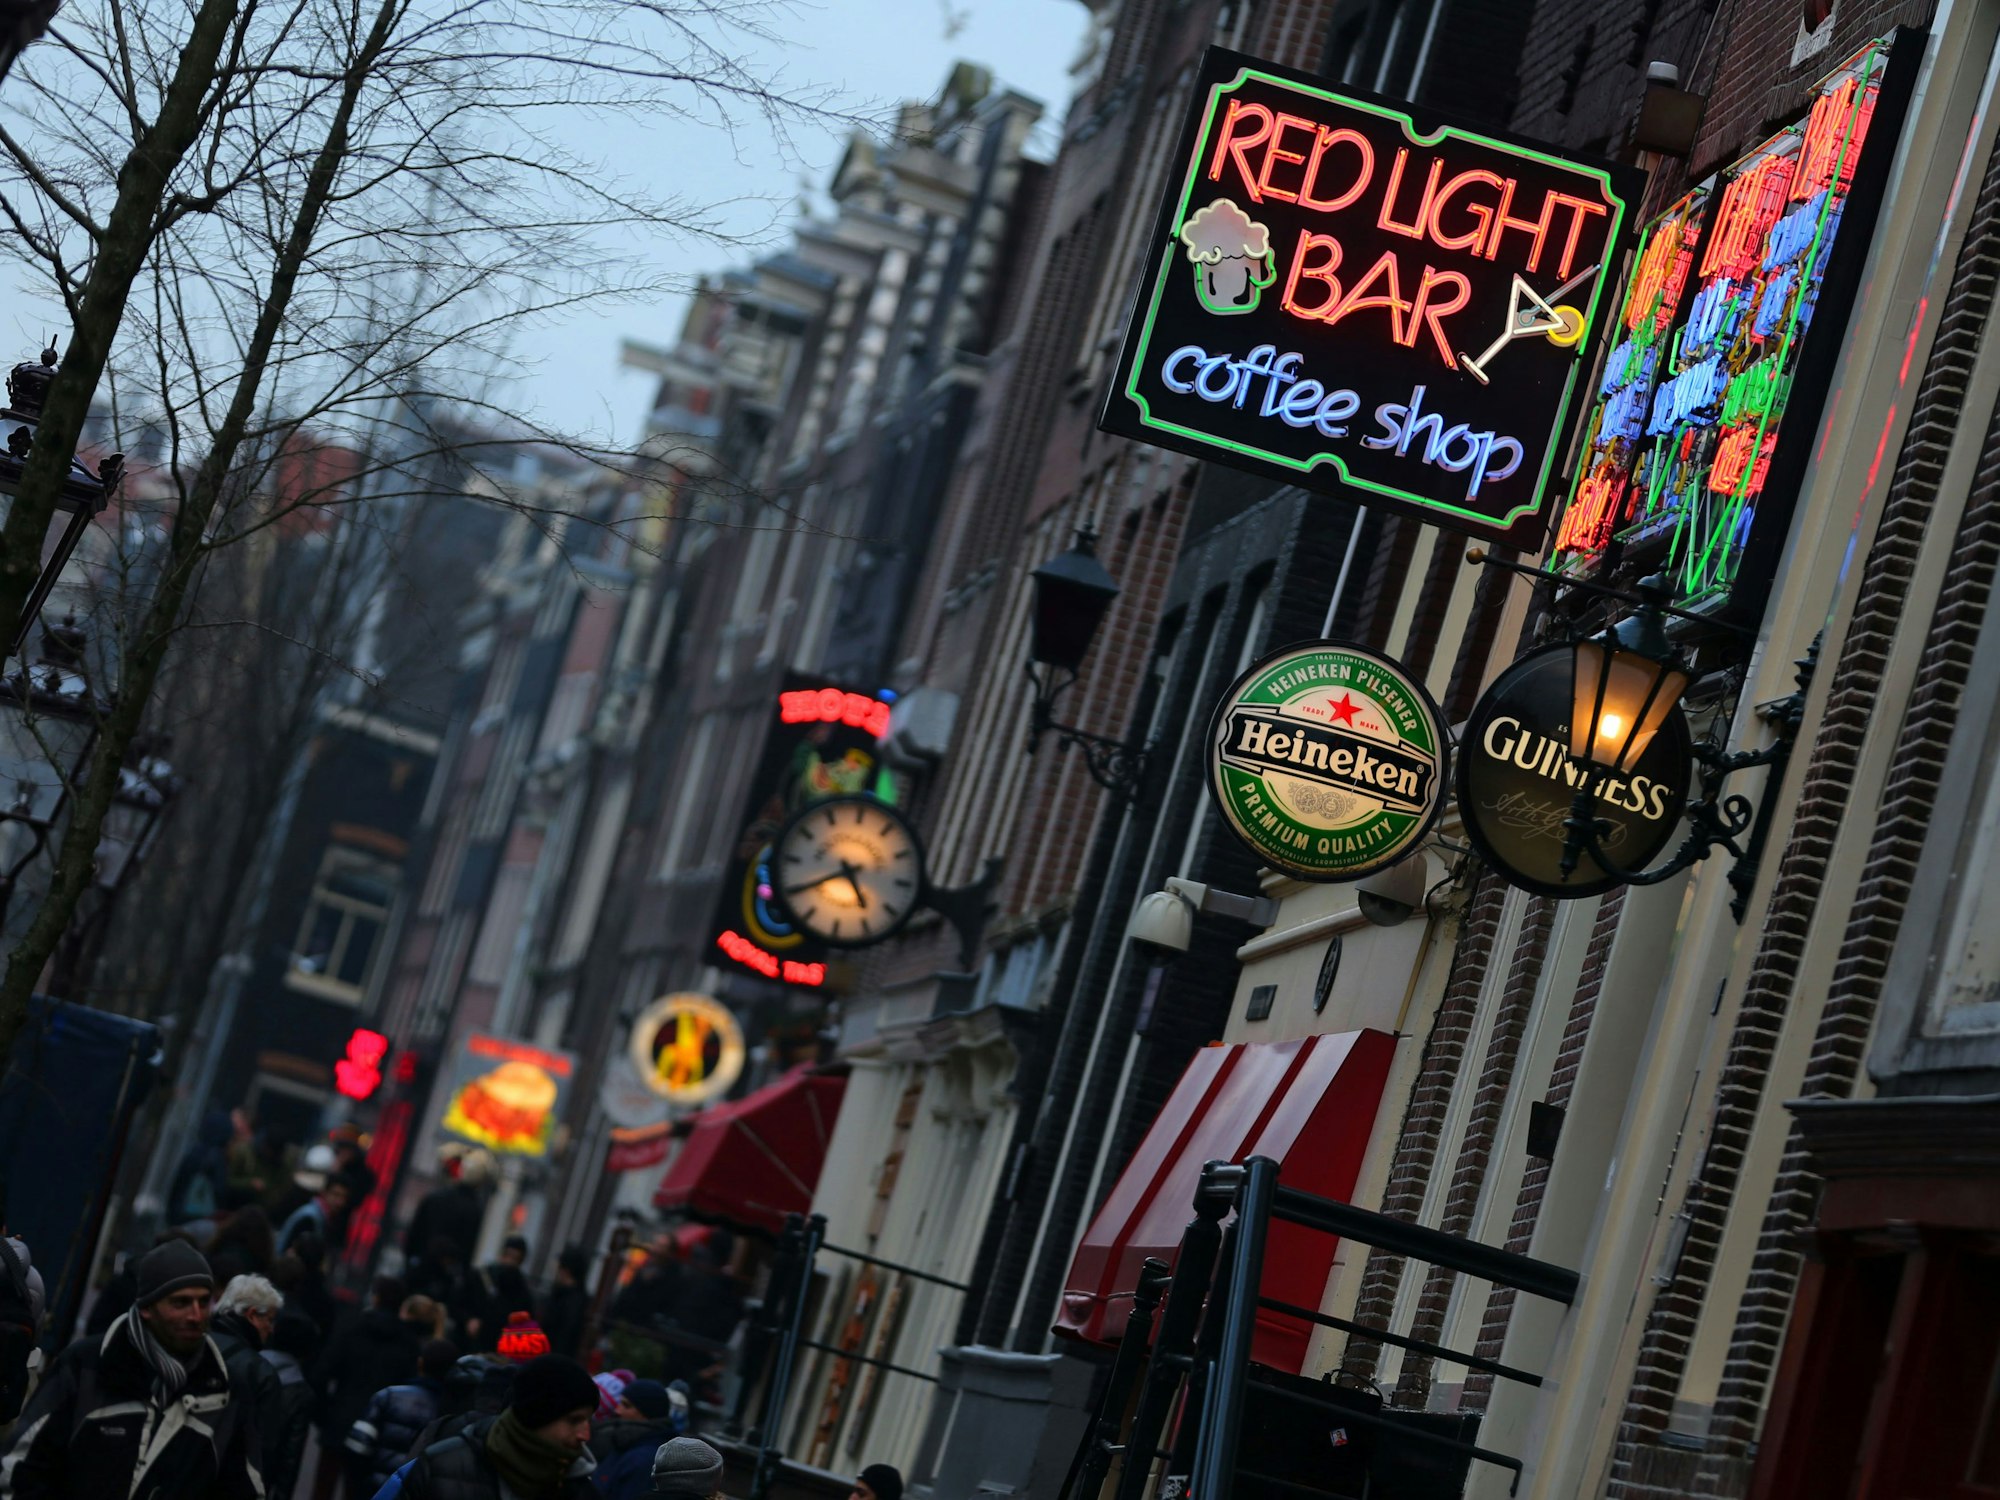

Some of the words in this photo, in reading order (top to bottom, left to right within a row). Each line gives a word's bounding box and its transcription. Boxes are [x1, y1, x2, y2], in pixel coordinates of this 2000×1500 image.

[1208, 99, 1375, 213] RED
[1377, 146, 1607, 282] LIGHT
[1280, 228, 1472, 371] BAR
[1162, 344, 1361, 438] coffee
[1360, 384, 1524, 501] shop
[1267, 663, 1352, 699] HEINEKEN
[1355, 670, 1418, 732] PILSENER
[1315, 654, 1366, 667] TRADITIONEEL
[1367, 663, 1392, 680] RECEPT
[1302, 705, 1325, 716] TRADE
[1359, 720, 1379, 731] MARK
[1239, 781, 1310, 851] PREMIUM
[1317, 817, 1394, 855] QUALITY
